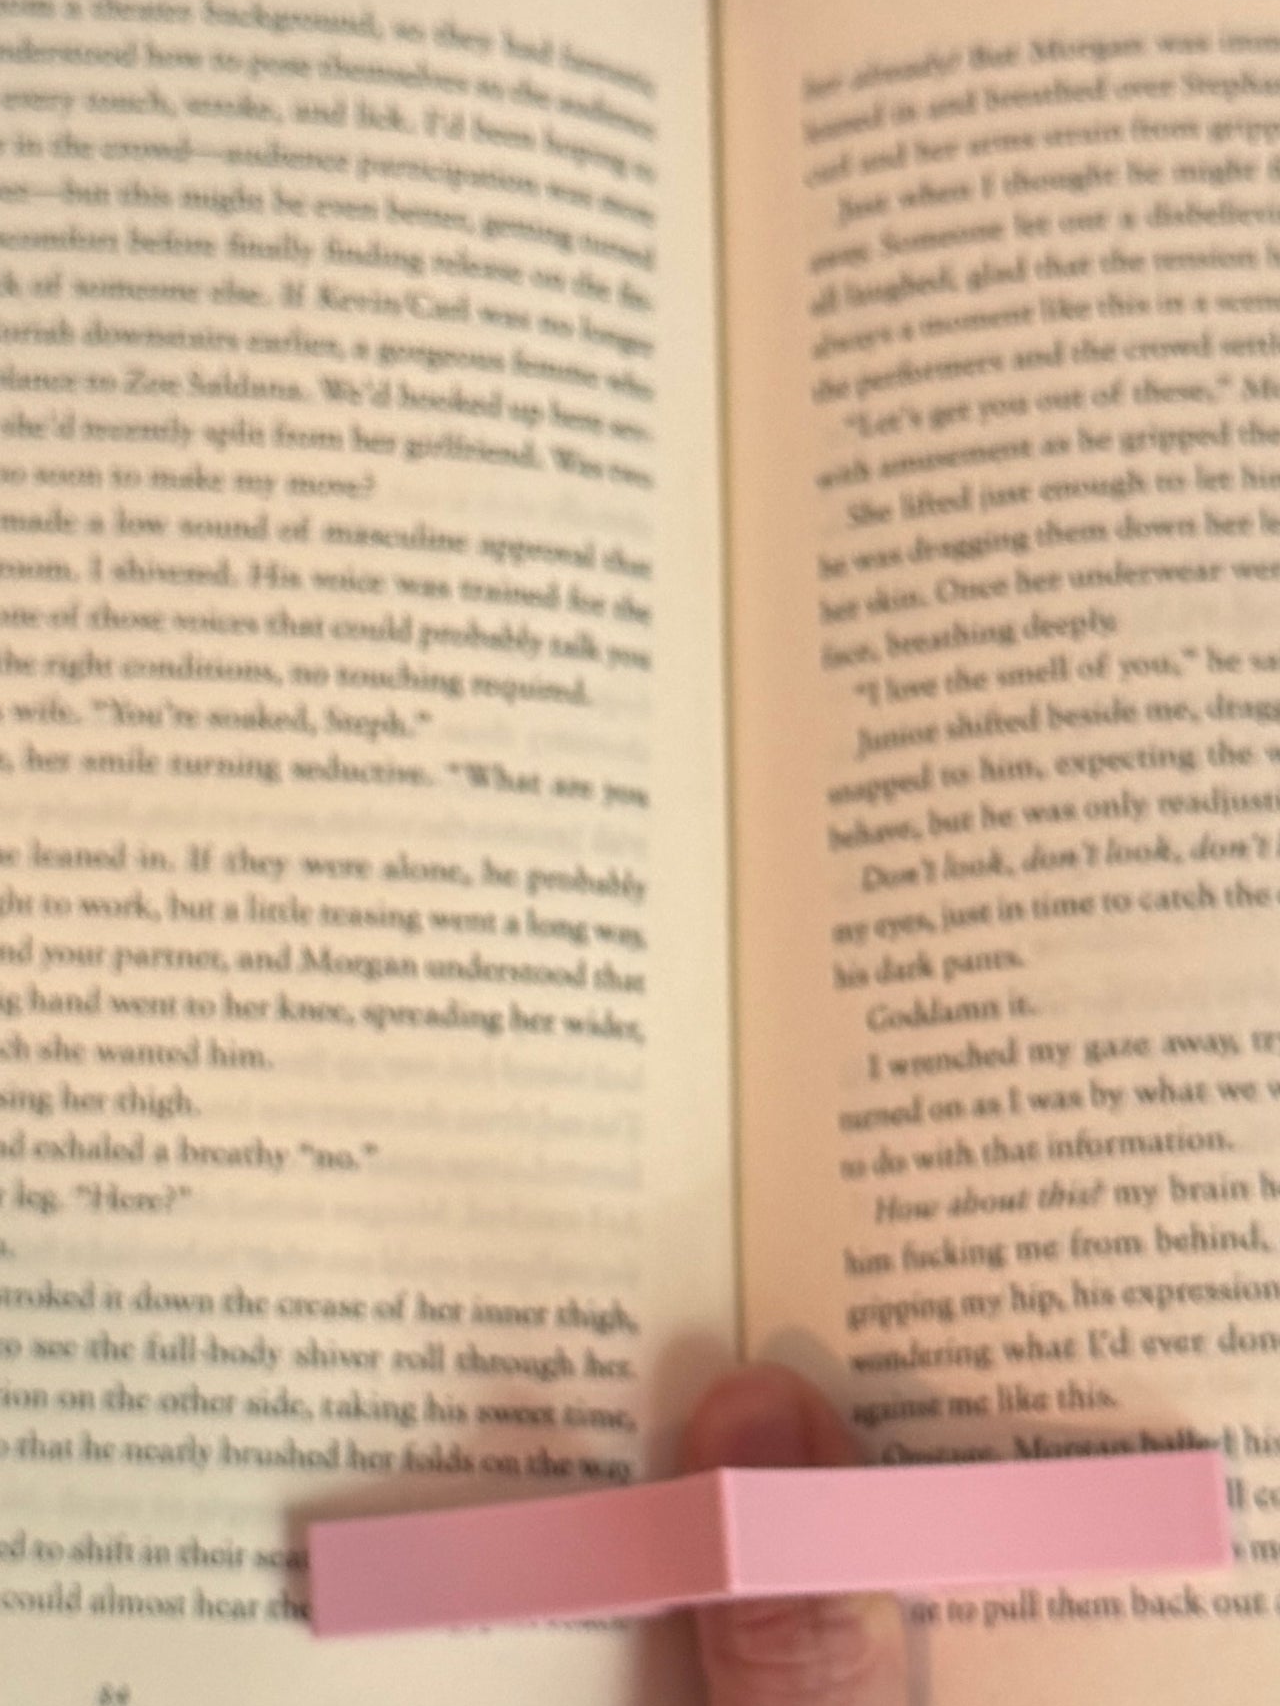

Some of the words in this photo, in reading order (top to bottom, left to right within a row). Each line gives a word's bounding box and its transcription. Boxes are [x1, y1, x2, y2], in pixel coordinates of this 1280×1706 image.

[32, 1127, 148, 1163] exhaled
[176, 1131, 293, 1175] breathy
[874, 1142, 908, 1178] do
[915, 1136, 977, 1174] with
[982, 1131, 1041, 1168] that
[30, 1335, 78, 1361] see
[84, 1328, 135, 1363] the
[291, 1335, 380, 1371] shiver
[393, 1339, 445, 1373] roll
[456, 1341, 574, 1386] through
[0, 1577, 82, 1613] could
[90, 1580, 185, 1617] almost
[193, 1584, 256, 1619] hear
[950, 1593, 972, 1622] to
[986, 1587, 1041, 1629] pull
[1049, 1586, 1125, 1620] them
[1132, 1584, 1206, 1619] back
[1214, 1587, 1267, 1617] out
